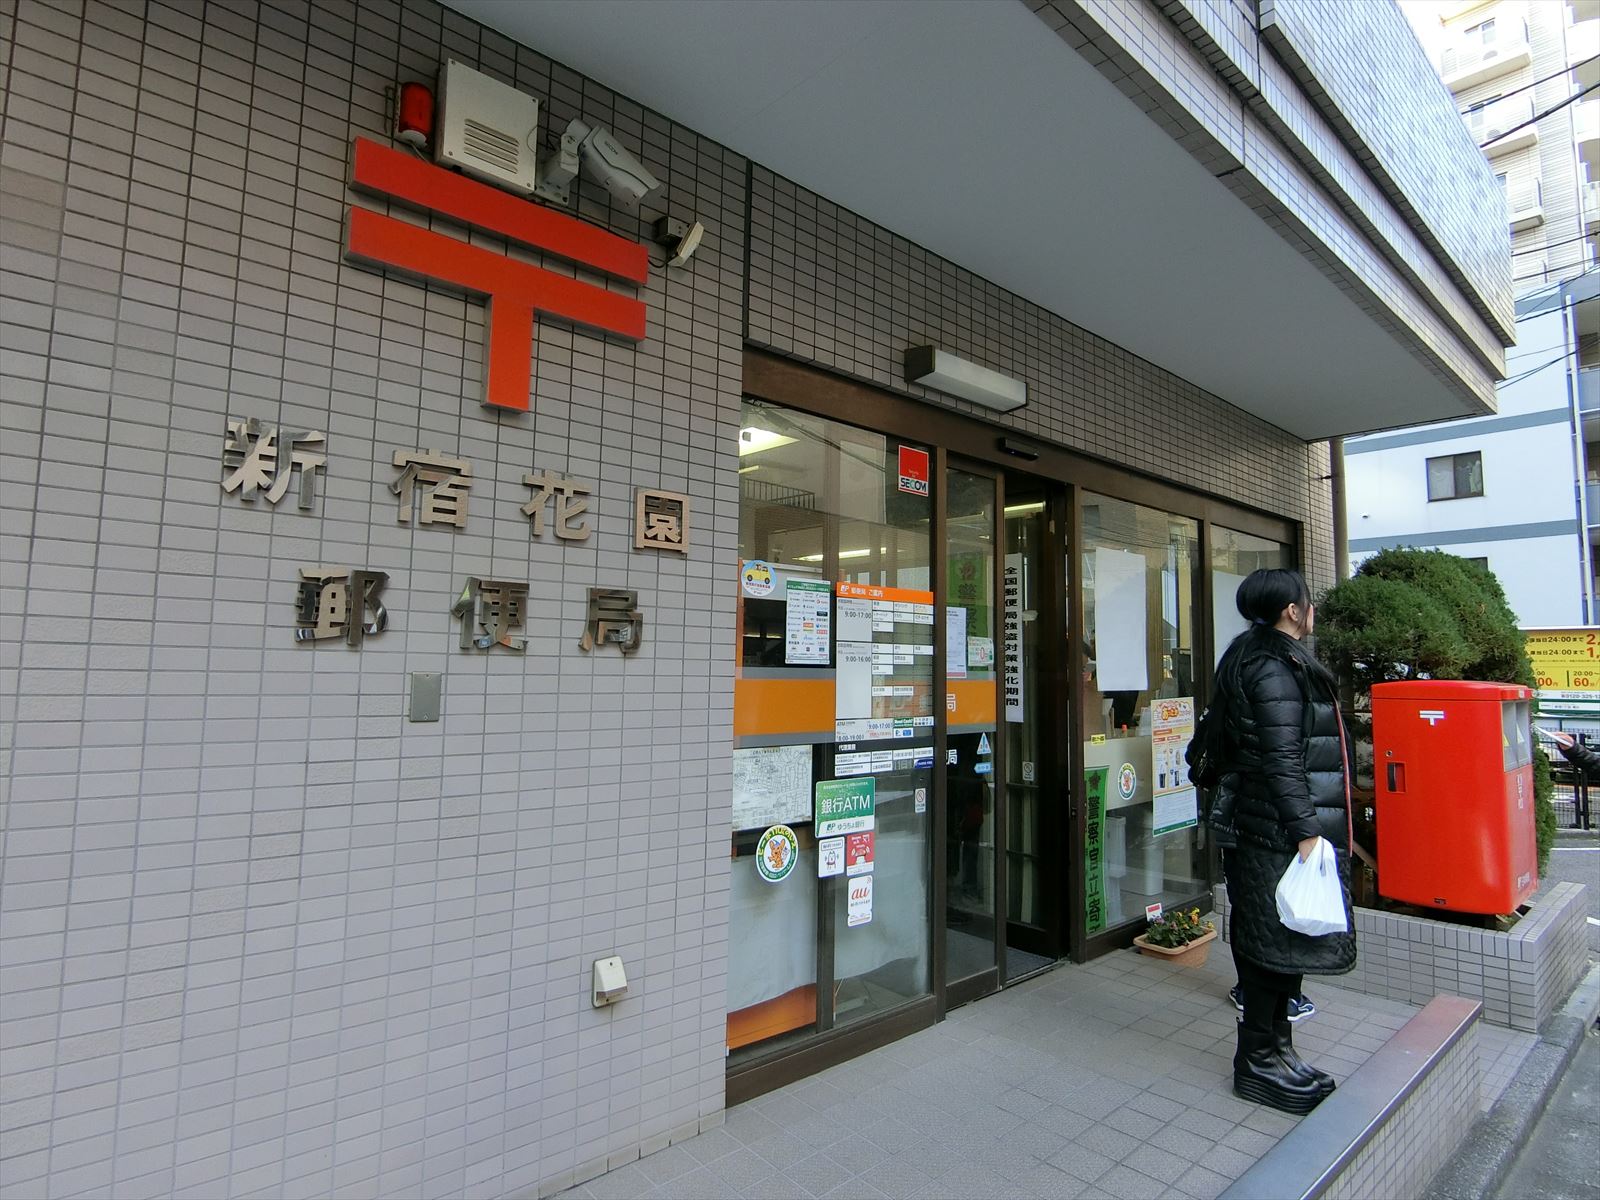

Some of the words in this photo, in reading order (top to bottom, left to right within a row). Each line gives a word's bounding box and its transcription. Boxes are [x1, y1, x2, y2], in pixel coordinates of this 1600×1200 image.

[221, 417, 691, 554] 新宿花園
[900, 477, 927, 492] SECOM
[296, 566, 644, 653] 郵便局
[844, 611, 872, 619] 9:00-17:00
[845, 655, 871, 663] 9:00-16:00
[821, 794, 871, 815] 銀行ATM
[851, 887, 870, 900] au
